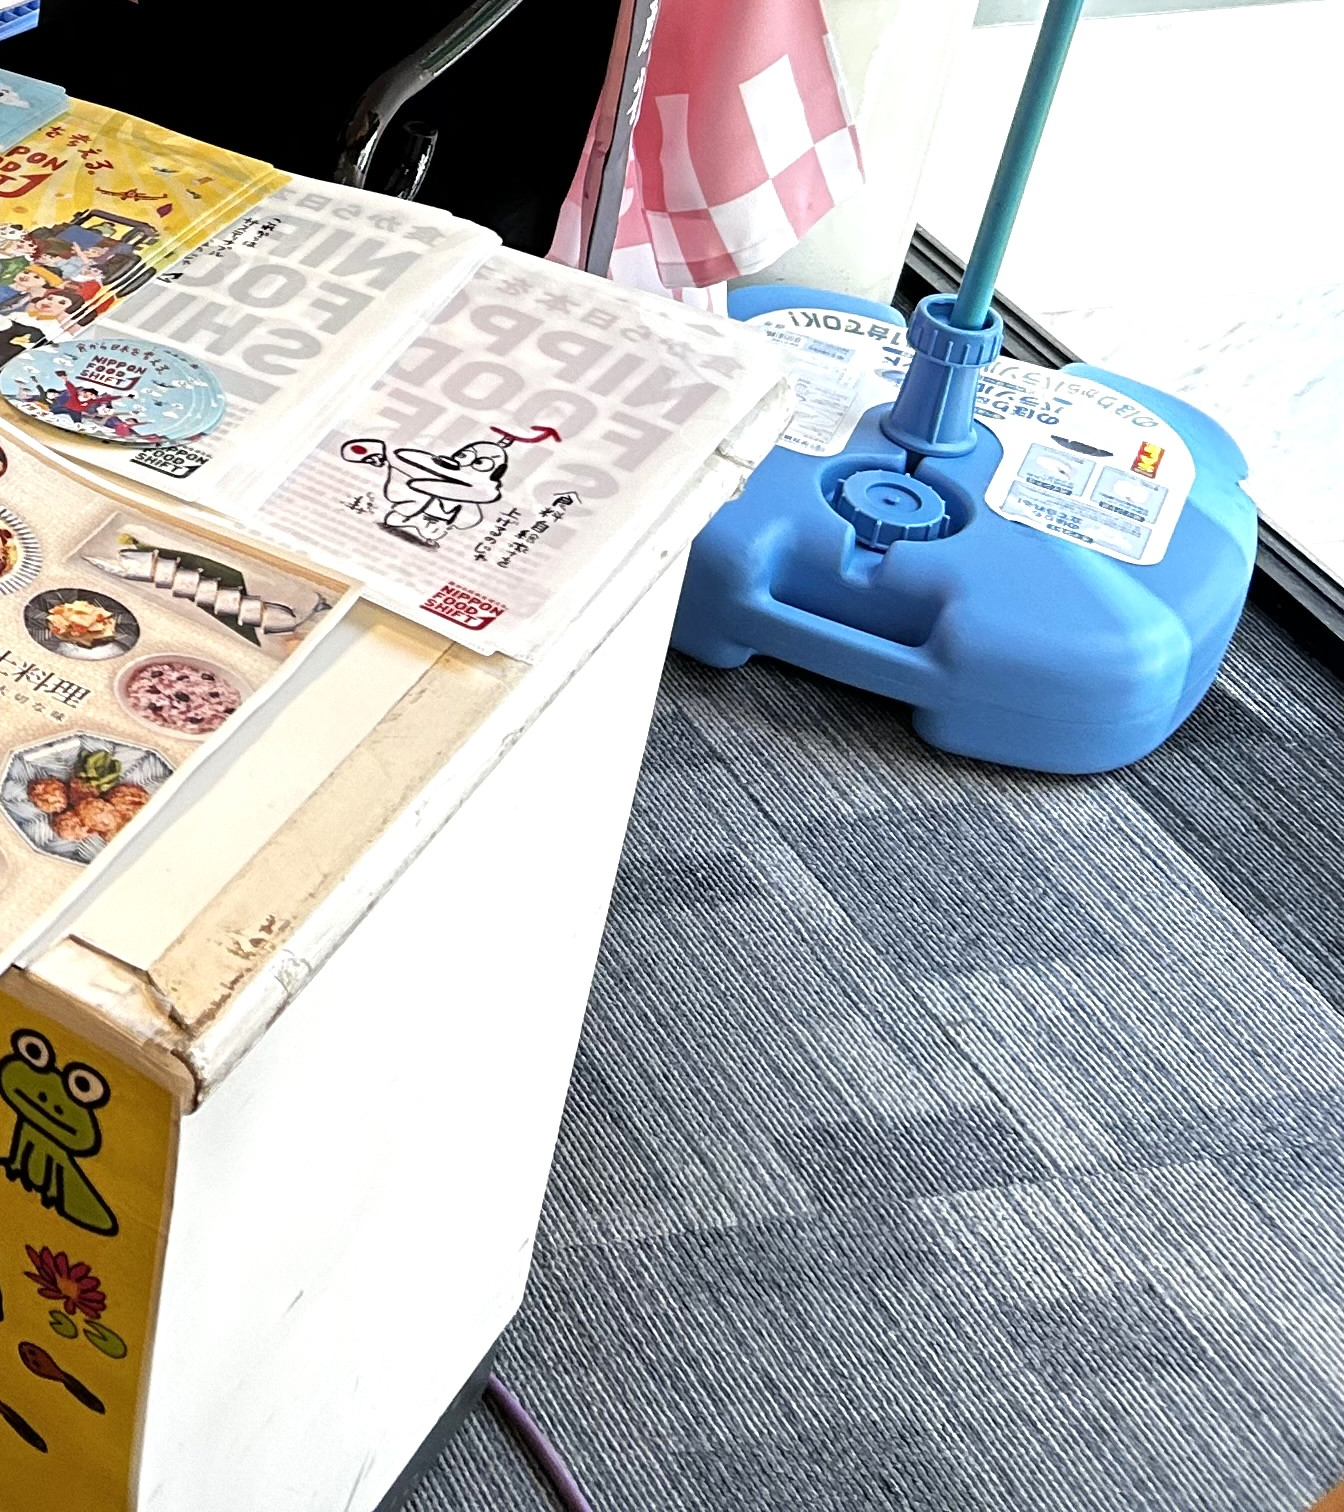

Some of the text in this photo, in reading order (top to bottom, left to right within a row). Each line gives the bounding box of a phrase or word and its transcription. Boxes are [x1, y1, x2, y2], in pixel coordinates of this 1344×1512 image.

[6, 146, 68, 172] PON
[45, 124, 114, 175] を考える。
[86, 363, 126, 377] FOOD
[91, 355, 148, 375] NIPPON
[79, 370, 127, 386] SHIFT
[135, 452, 184, 473] SHIFT
[425, 599, 478, 624] SHIFT
[433, 592, 478, 616] FOOD
[441, 585, 506, 617] NIPPON
